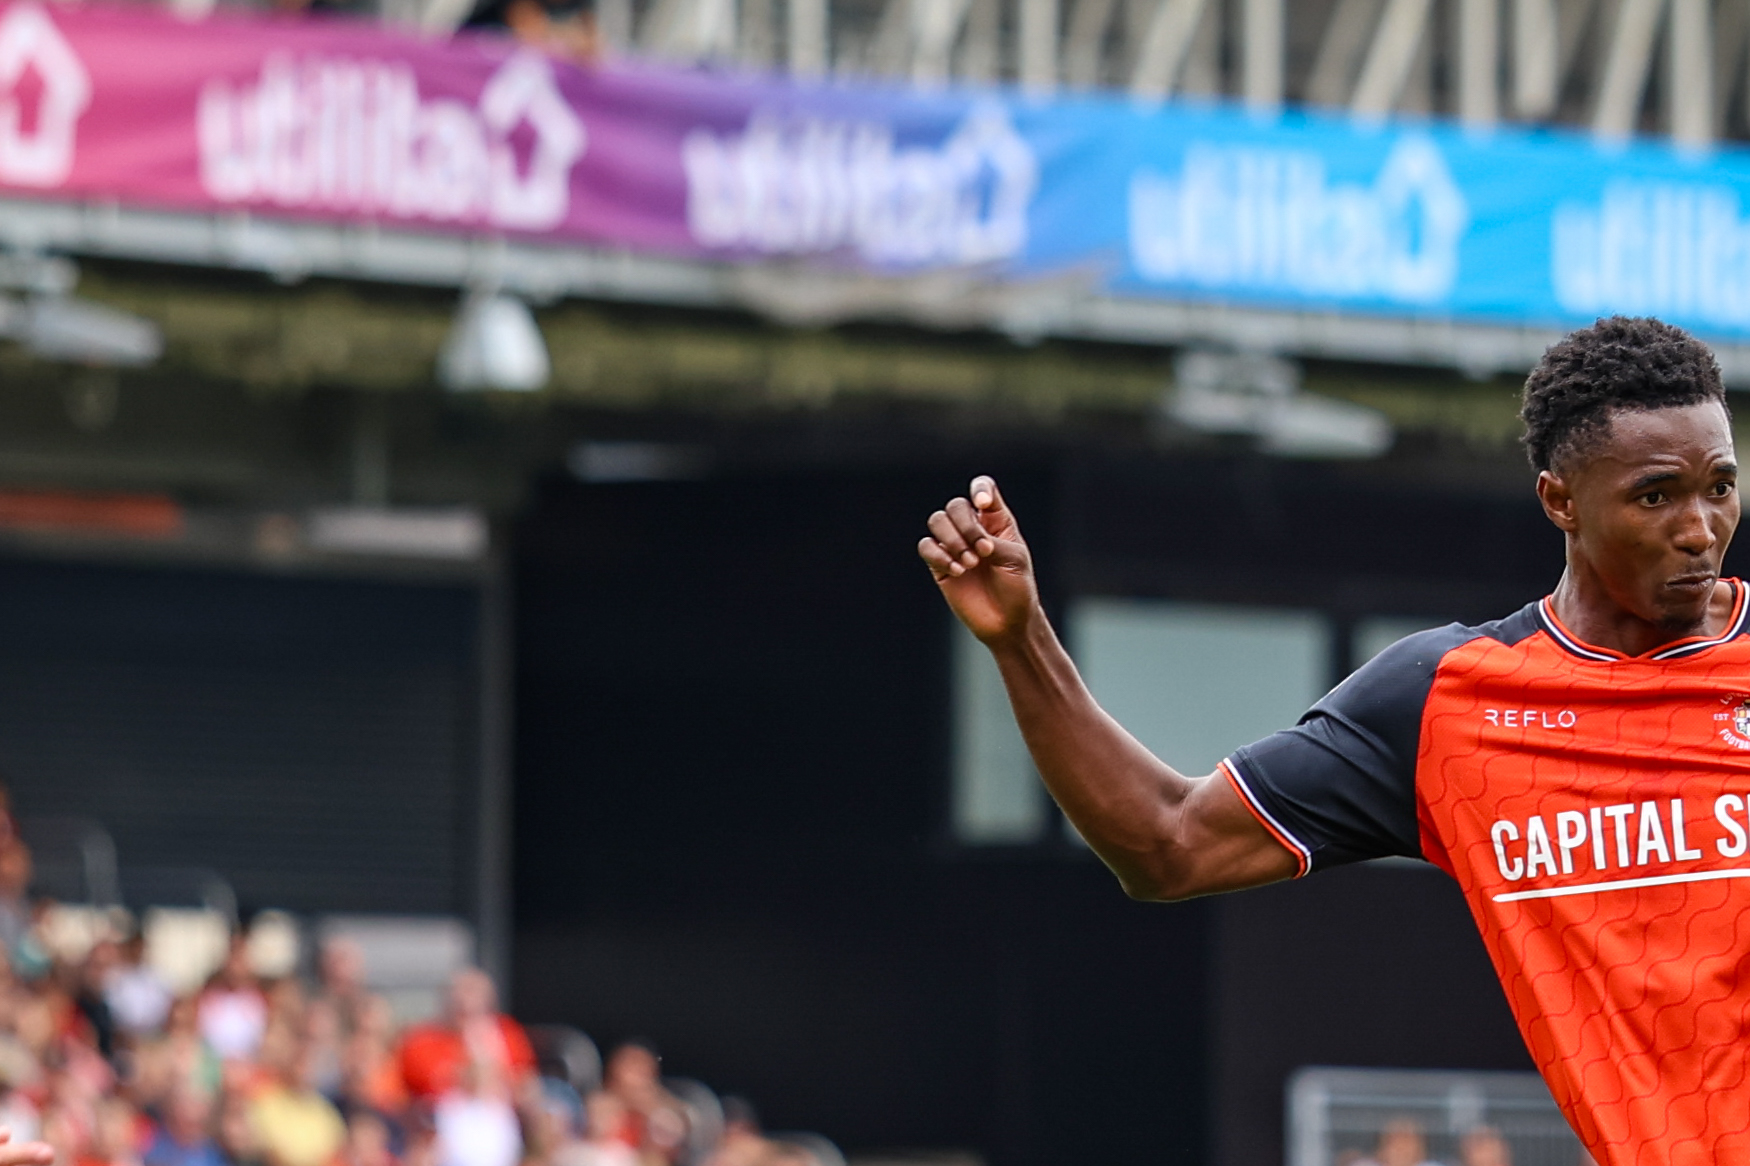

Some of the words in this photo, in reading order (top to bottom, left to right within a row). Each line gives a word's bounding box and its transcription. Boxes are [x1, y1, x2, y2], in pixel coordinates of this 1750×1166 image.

[1484, 709, 1577, 728] REFLO
[1713, 713, 1729, 721] EST
[1490, 798, 1702, 881] CAPITAL
